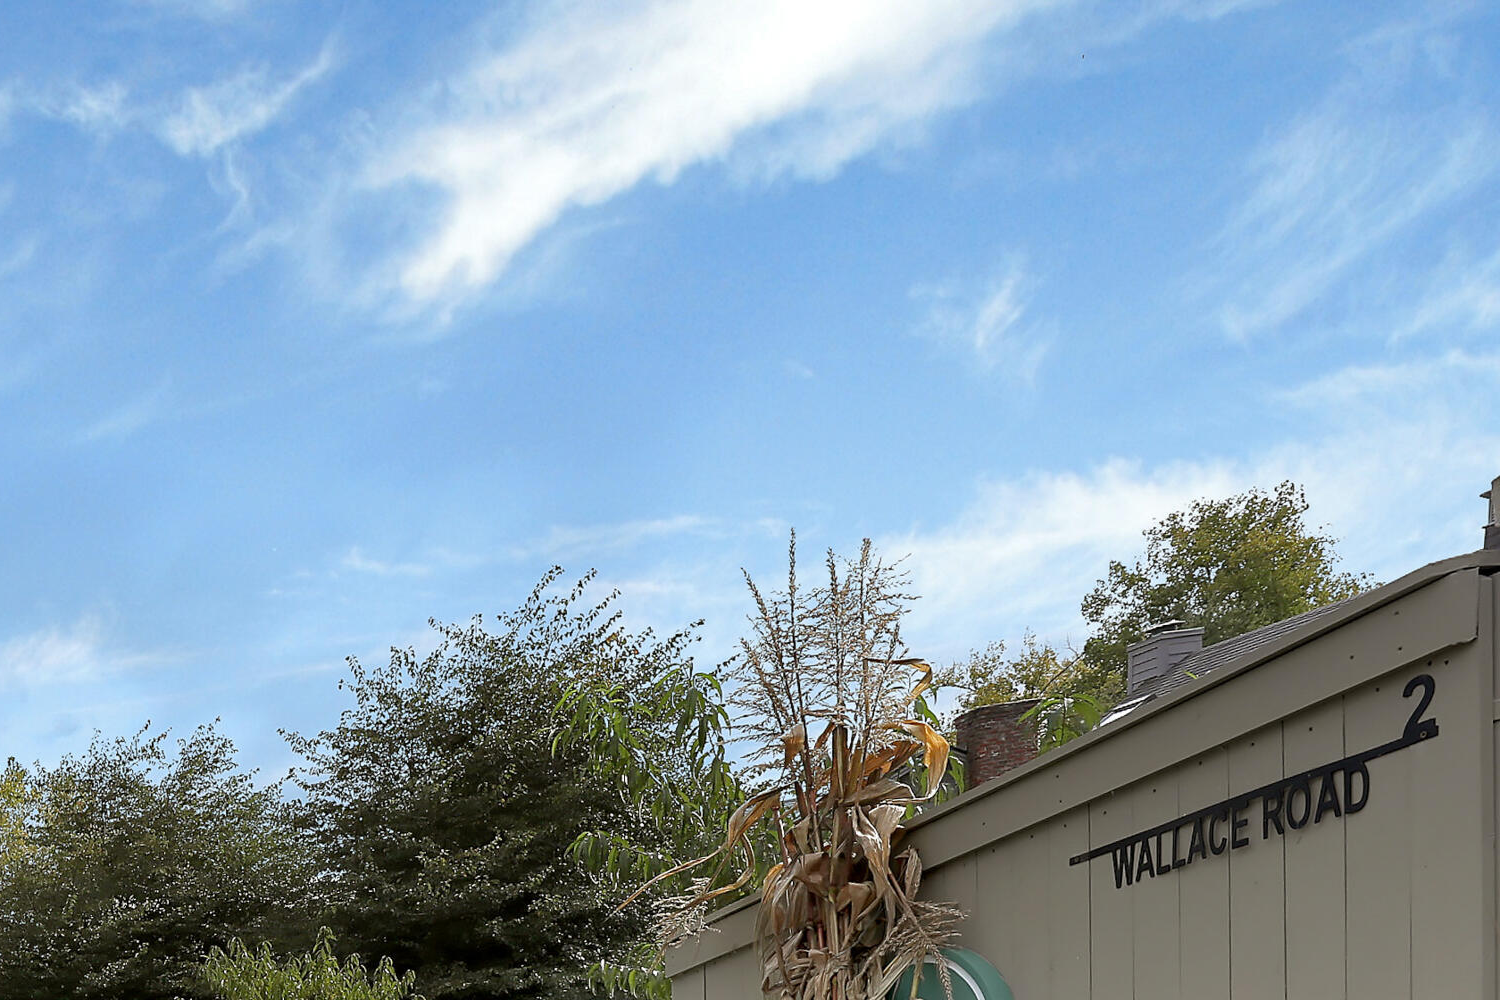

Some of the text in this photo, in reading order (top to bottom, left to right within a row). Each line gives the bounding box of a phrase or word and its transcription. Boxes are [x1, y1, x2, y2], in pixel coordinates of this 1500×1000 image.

[1402, 673, 1438, 739] 2
[1110, 762, 1370, 889] WALLACE ROAD
